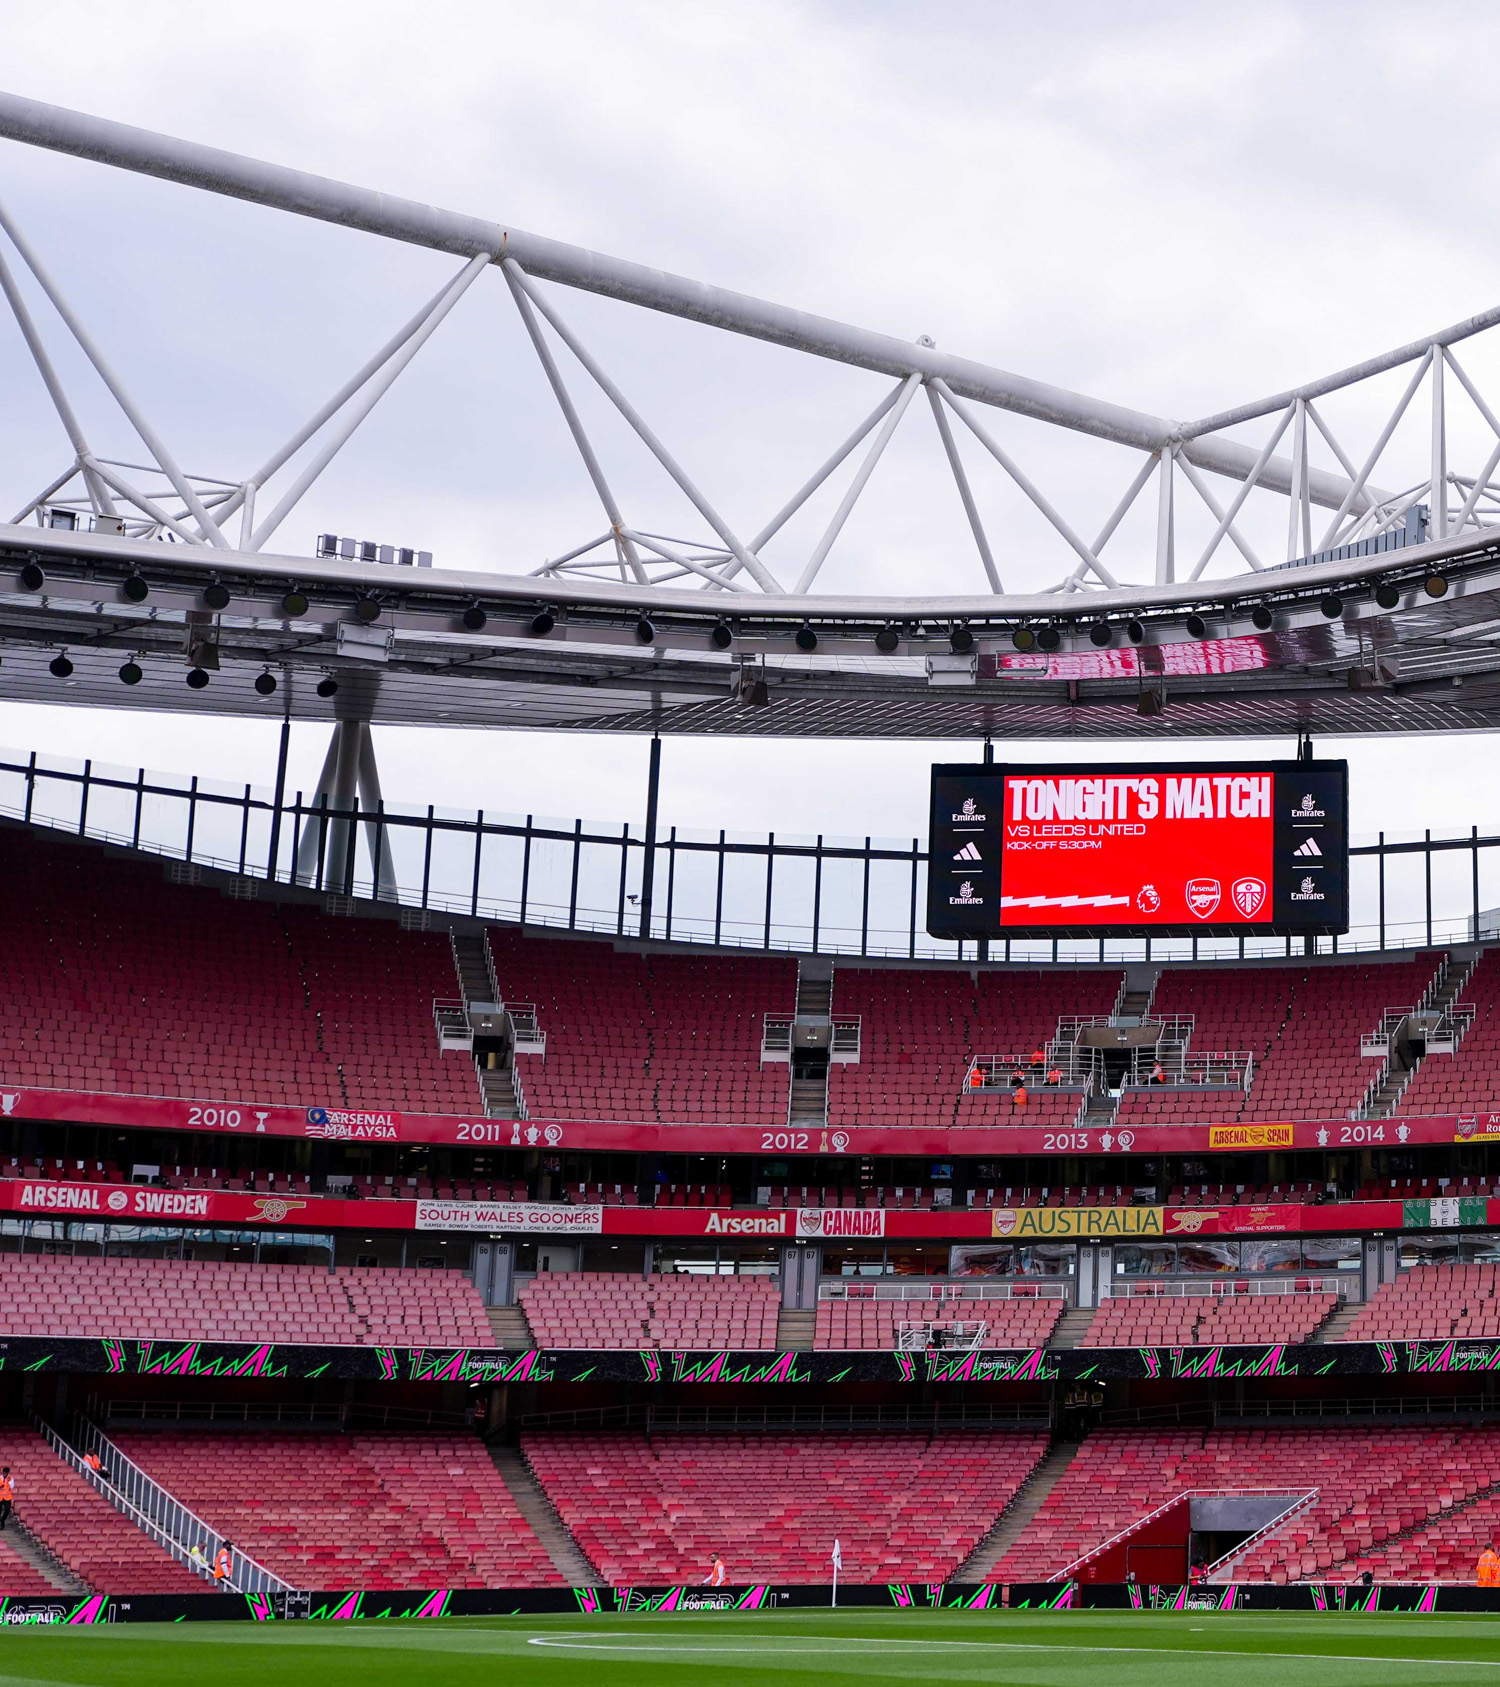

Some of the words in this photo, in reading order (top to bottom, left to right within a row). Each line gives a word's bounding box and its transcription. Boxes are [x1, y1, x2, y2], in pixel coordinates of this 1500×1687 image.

[1008, 778, 1159, 821] TONIGHT'S
[1165, 776, 1271, 819] MATCH
[952, 813, 986, 822] Emirates
[1291, 809, 1325, 817] Emirates
[1007, 825, 1029, 837] VS
[1033, 824, 1086, 836] LEEDS
[1089, 824, 1146, 836] UNITED
[1006, 840, 1057, 850] KICK-OFF
[1059, 840, 1102, 849] 5.30PM
[949, 896, 984, 905] Emirates
[1290, 892, 1325, 900] Emirates
[187, 1107, 241, 1127] 2010
[329, 1112, 394, 1126] ARSENAL
[324, 1123, 397, 1139] MALAYSIA
[456, 1123, 500, 1141] 2011
[1213, 1130, 1249, 1144] ARSENAL
[1267, 1128, 1290, 1143] SPAIN
[1340, 1125, 1385, 1143] 2014
[760, 1132, 808, 1150] 2012
[1043, 1133, 1089, 1150] 2013
[20, 1185, 100, 1210] ARSENAL
[135, 1191, 208, 1216] SWEDEN
[1405, 1197, 1484, 1208] ARSENAL
[419, 1209, 470, 1222] SOUTH
[474, 1210, 524, 1223] WALES
[528, 1212, 600, 1224] GOONERS
[704, 1212, 786, 1234] Arsenal
[823, 1210, 882, 1236] CANADA
[1019, 1209, 1160, 1234] AUSTRALIA
[1405, 1216, 1485, 1227] NIGERIA
[787, 1251, 796, 1259] 67
[806, 1251, 815, 1260] 67
